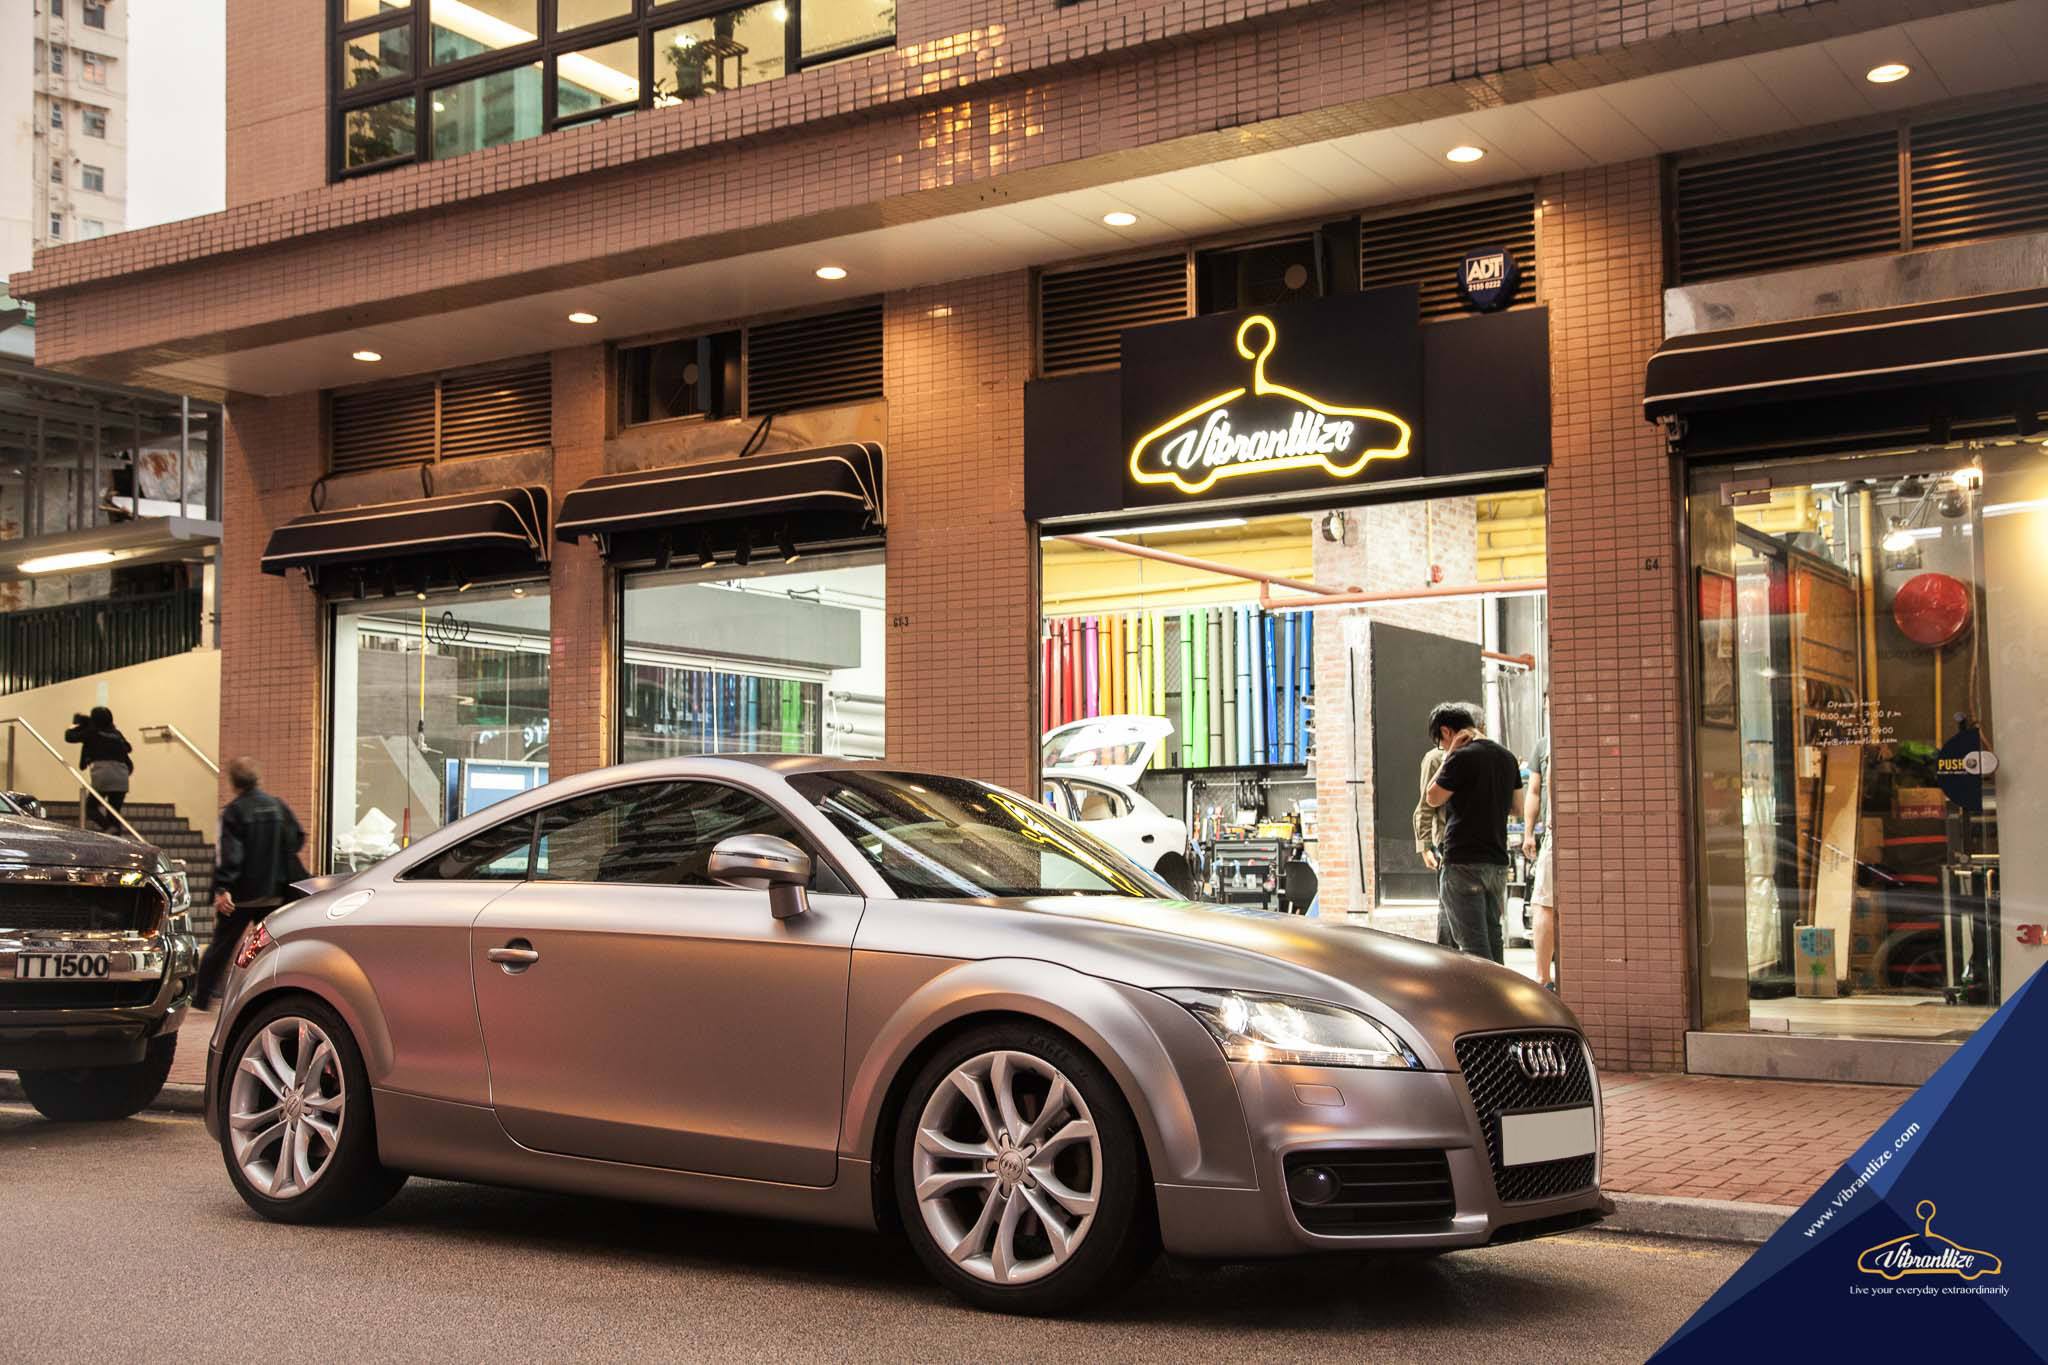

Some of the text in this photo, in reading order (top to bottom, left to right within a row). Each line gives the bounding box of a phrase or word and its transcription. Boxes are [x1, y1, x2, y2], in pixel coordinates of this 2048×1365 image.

[1468, 257, 1502, 282] ADT
[1827, 701, 1858, 709] Opening
[1938, 759, 1966, 770] PUSH
